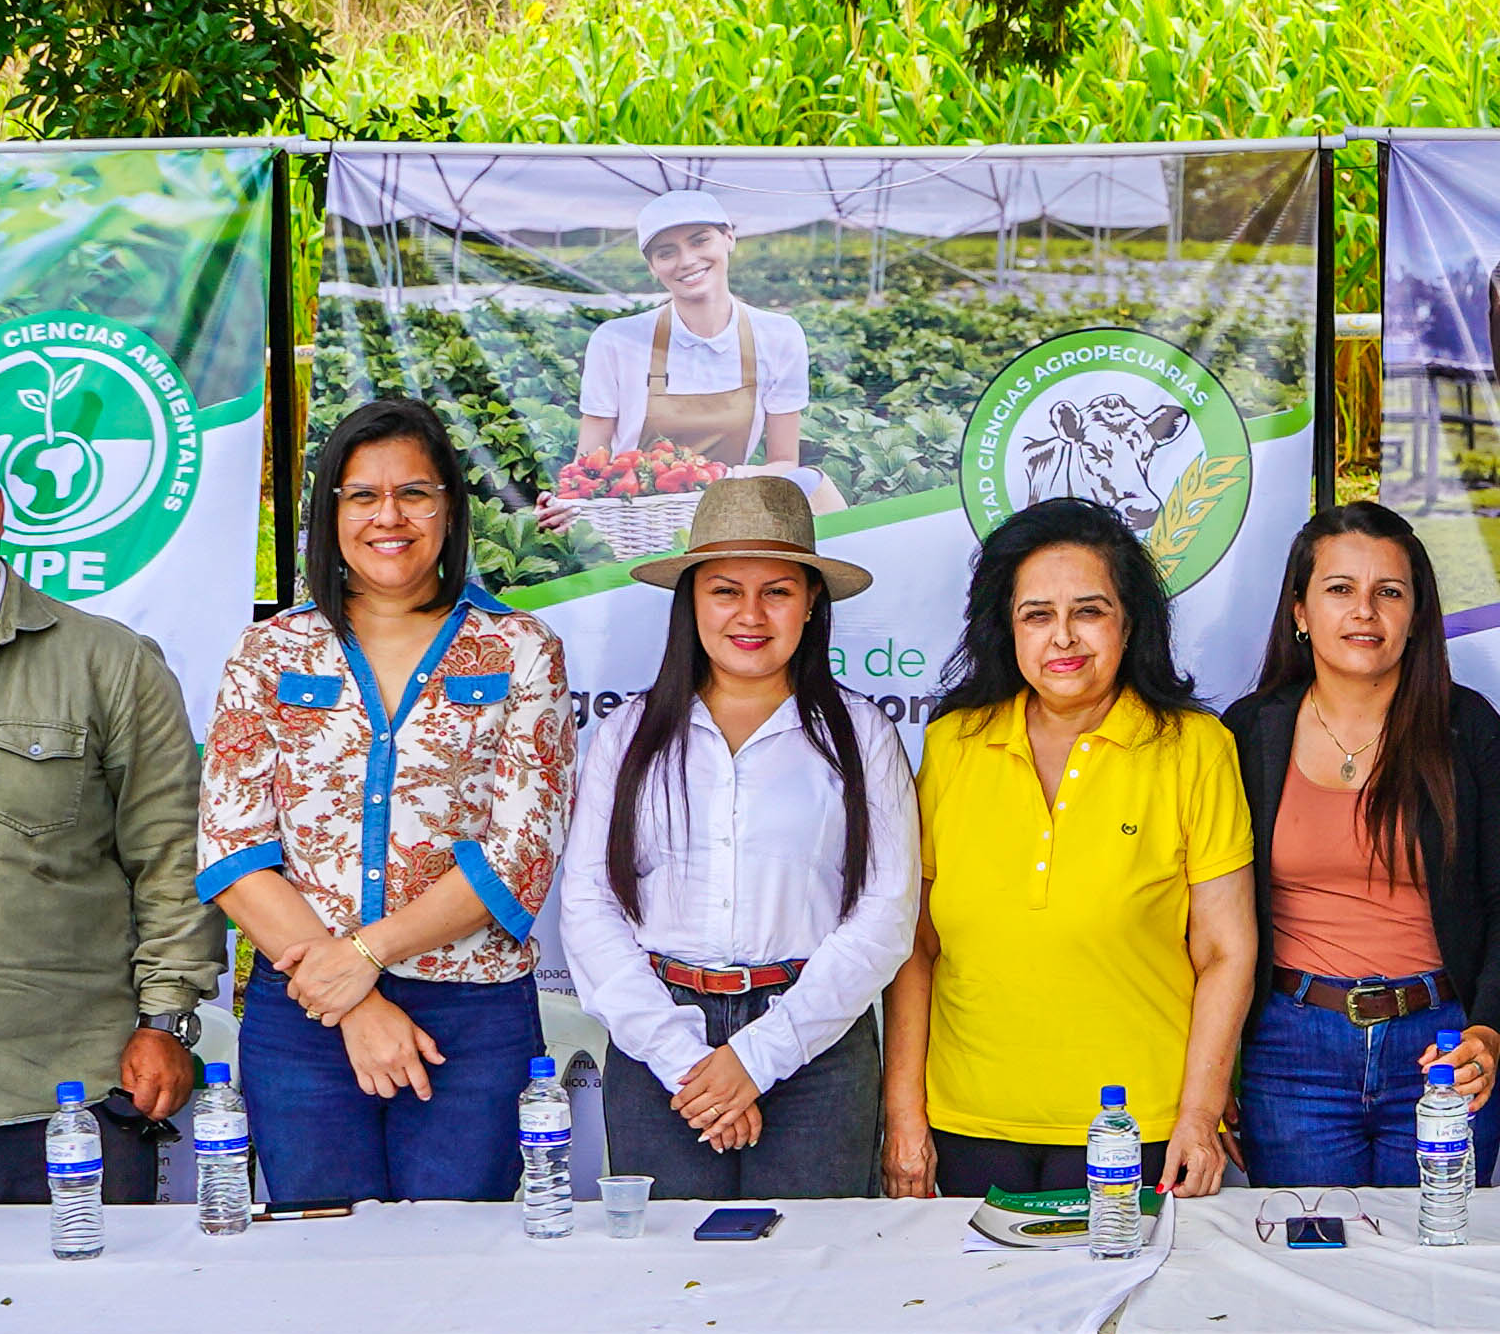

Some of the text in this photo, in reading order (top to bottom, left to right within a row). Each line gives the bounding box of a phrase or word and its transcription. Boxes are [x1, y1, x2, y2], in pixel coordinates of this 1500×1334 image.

[3, 322, 127, 349] CIENCIAS
[127, 344, 197, 513] AMBIENTALES
[978, 376, 1032, 469] CIENCIAS
[1033, 344, 1209, 408] AGROPECUARIAS
[864, 638, 925, 677] de
